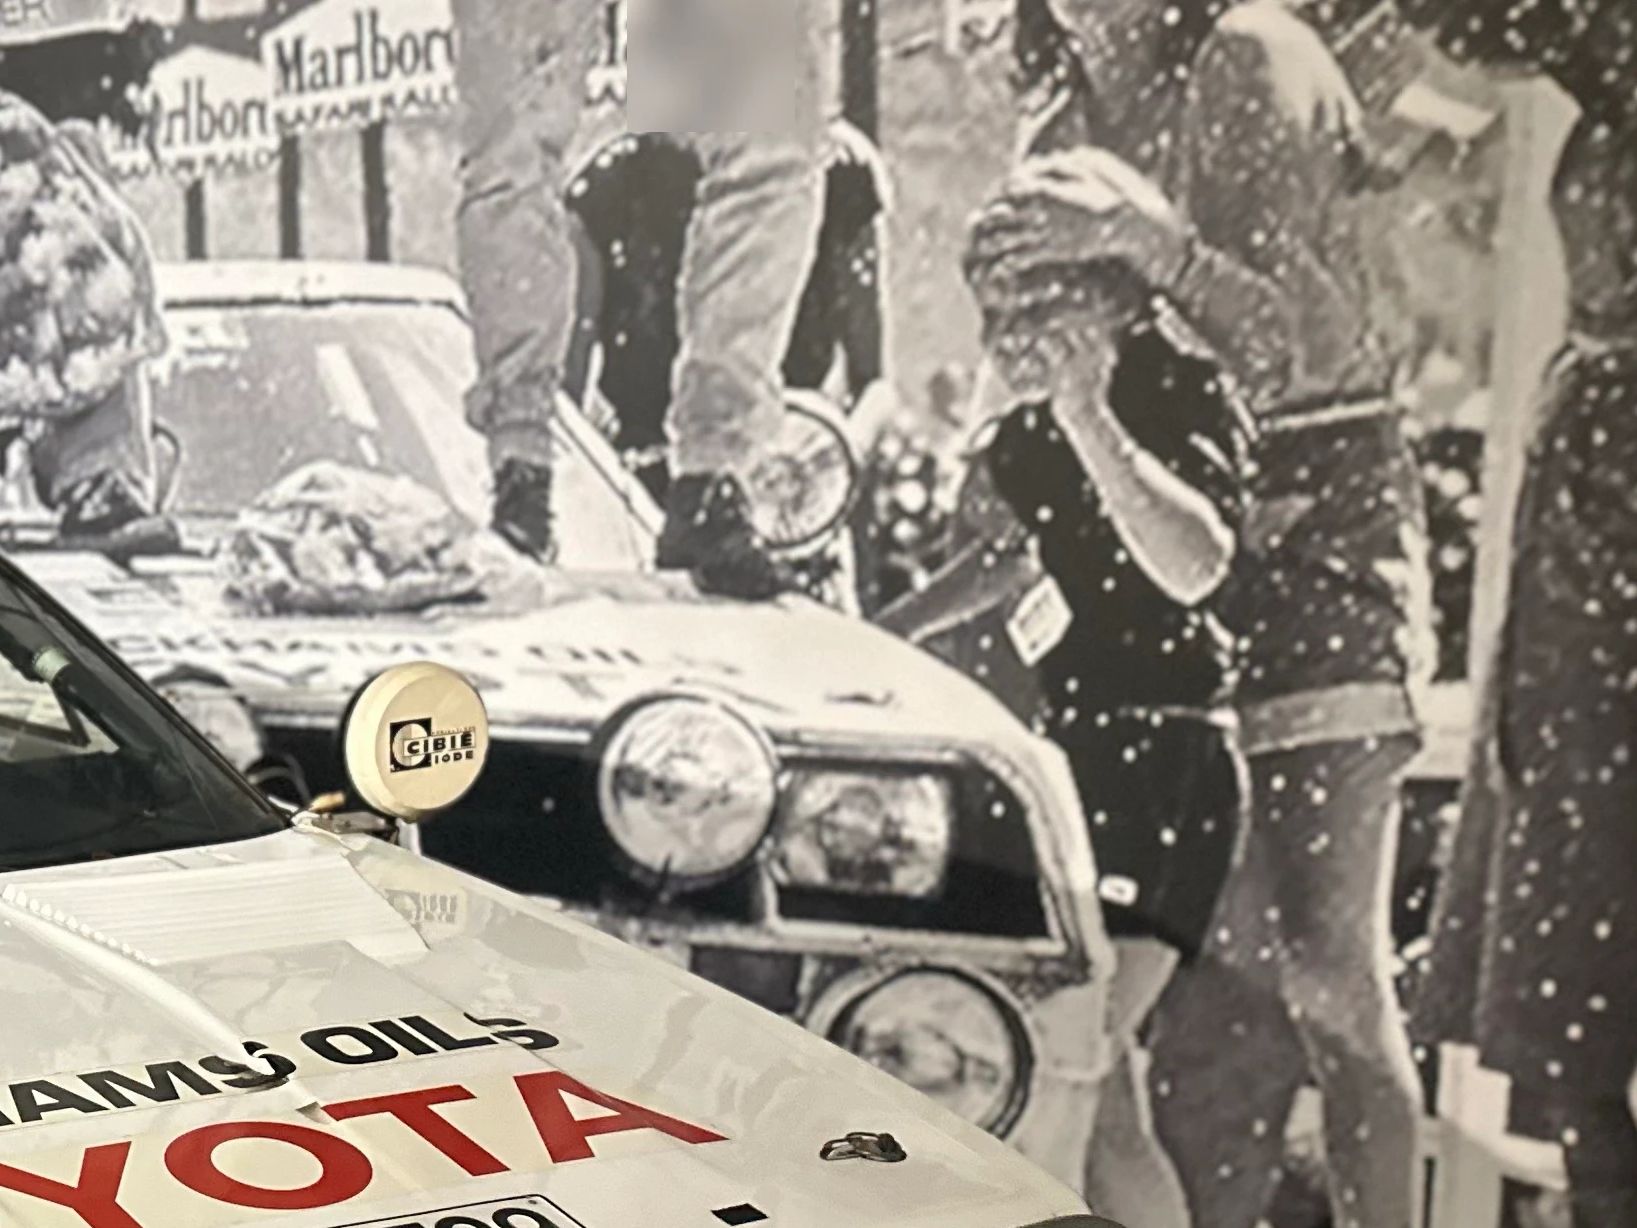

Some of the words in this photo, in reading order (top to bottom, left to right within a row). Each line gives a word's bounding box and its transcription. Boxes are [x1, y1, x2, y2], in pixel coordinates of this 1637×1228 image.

[273, 7, 455, 96] Marlbor
[434, 750, 474, 764] IODE
[299, 1010, 561, 1068] OILS
